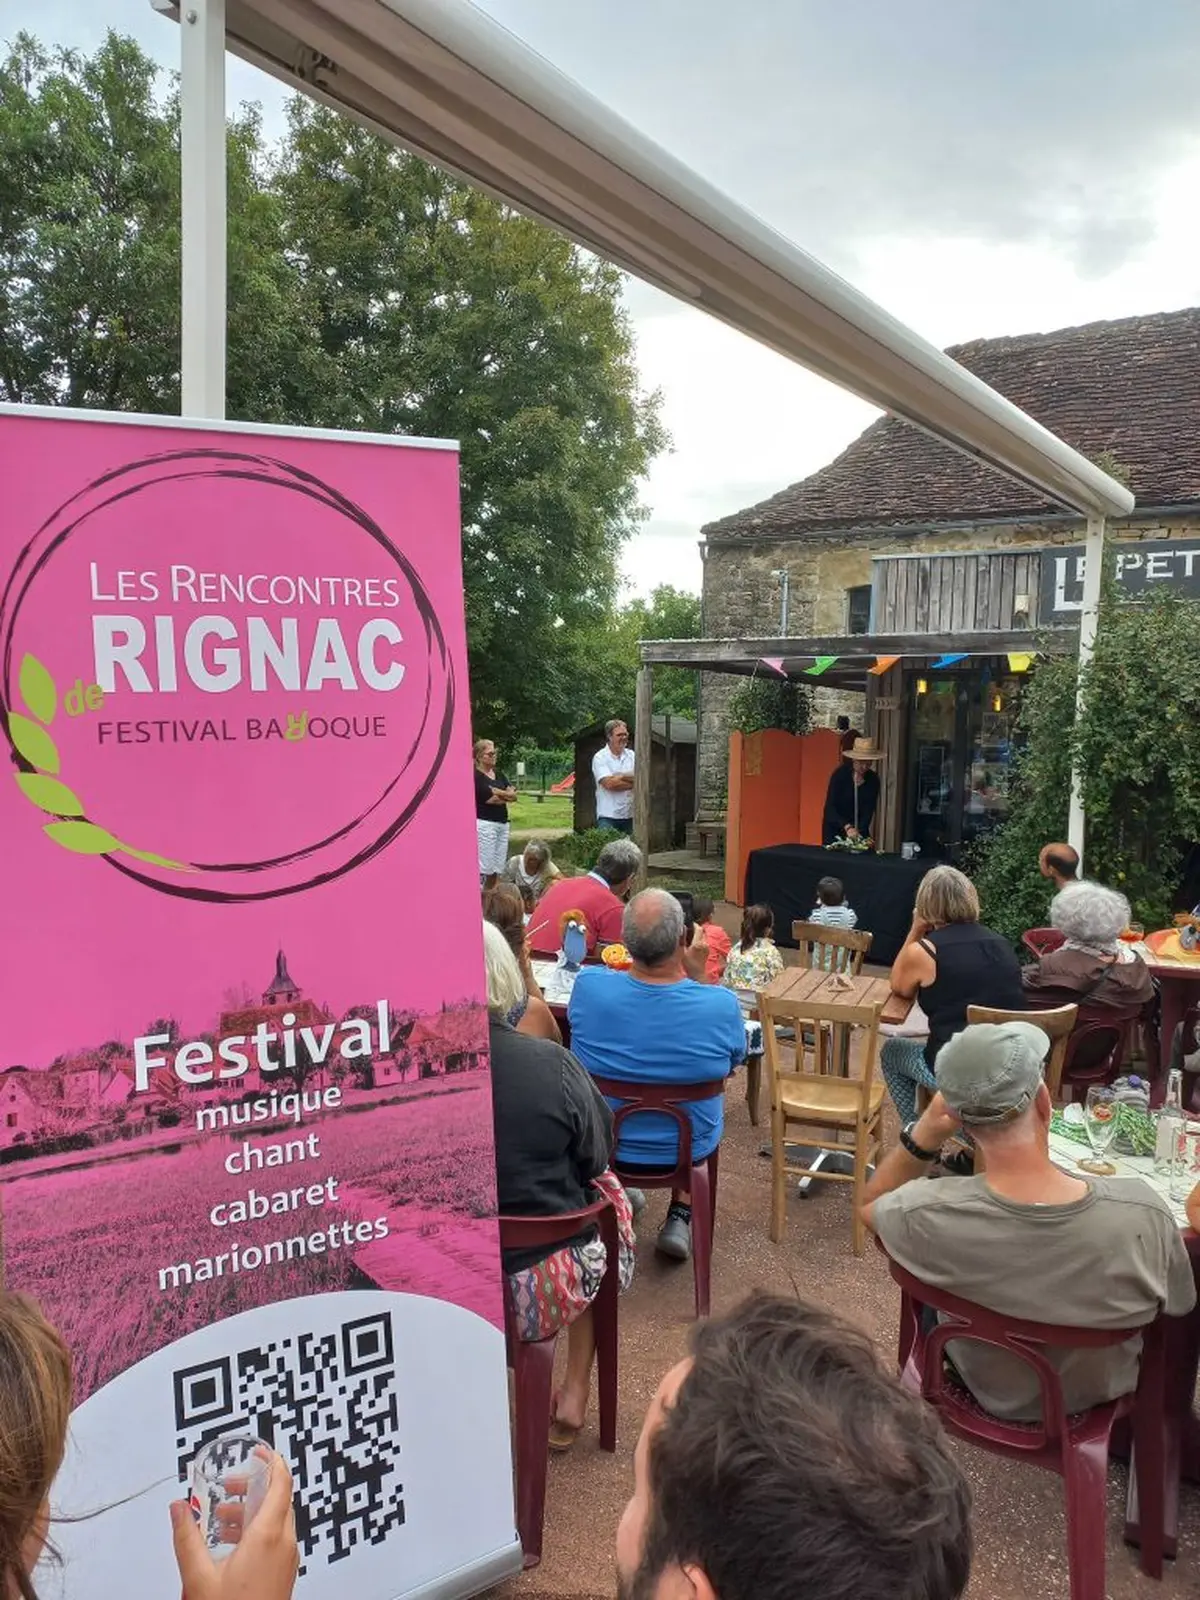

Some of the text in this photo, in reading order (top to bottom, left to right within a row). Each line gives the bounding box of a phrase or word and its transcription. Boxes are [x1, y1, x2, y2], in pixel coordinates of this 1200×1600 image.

[171, 565, 400, 607] RENCONTRES
[1115, 550, 1200, 580] PET
[64, 615, 405, 717] de RIGNAC
[98, 710, 387, 744] FESTIVAL BAROQUE
[133, 1000, 390, 1091] Festival
[196, 1086, 342, 1130] musique
[224, 1133, 321, 1174] chant
[210, 1176, 339, 1226] cabaret
[157, 1216, 390, 1290] marionnettes
